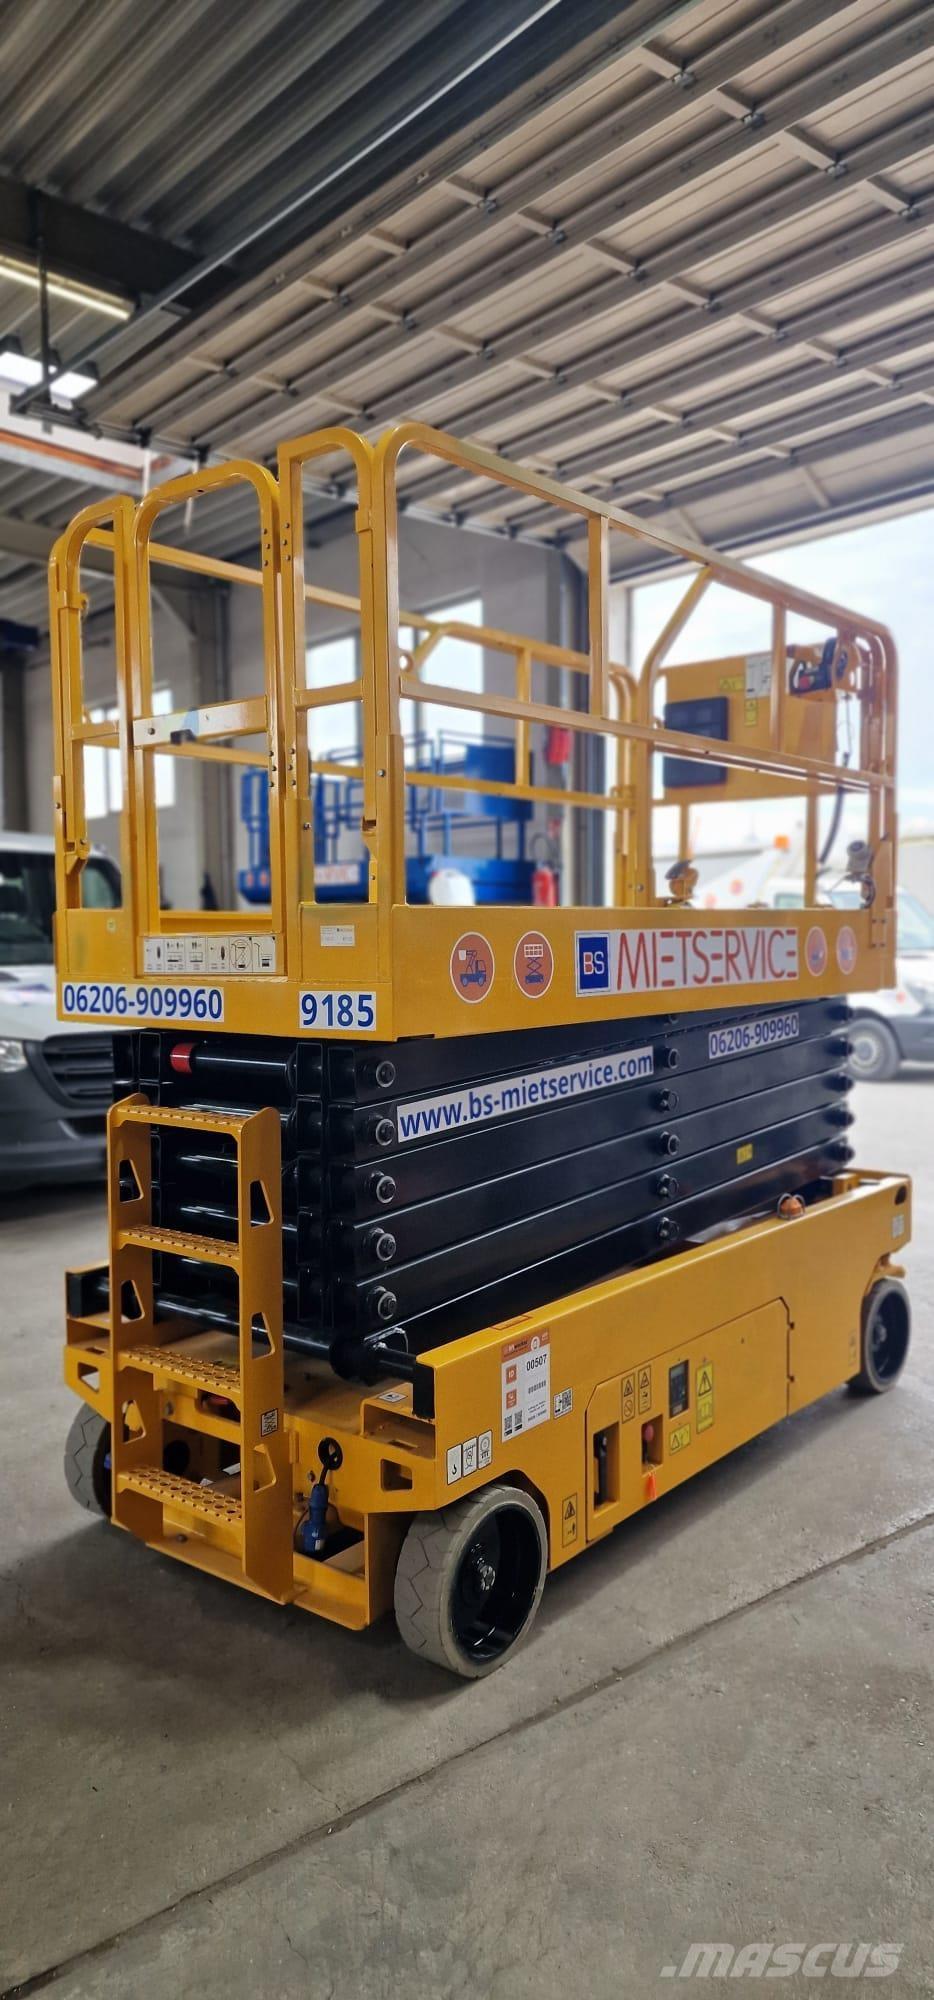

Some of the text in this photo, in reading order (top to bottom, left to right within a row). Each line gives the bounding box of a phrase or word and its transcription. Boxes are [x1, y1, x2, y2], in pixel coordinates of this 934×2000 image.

[583, 929, 798, 991] BS MIETSERVICE
[63, 984, 223, 1019] 06206-909960
[301, 993, 374, 1027] 9185
[710, 1014, 799, 1056] 06206-909960
[399, 1053, 653, 1138] www.bs-mietservice.com
[526, 1353, 547, 1371] 00507
